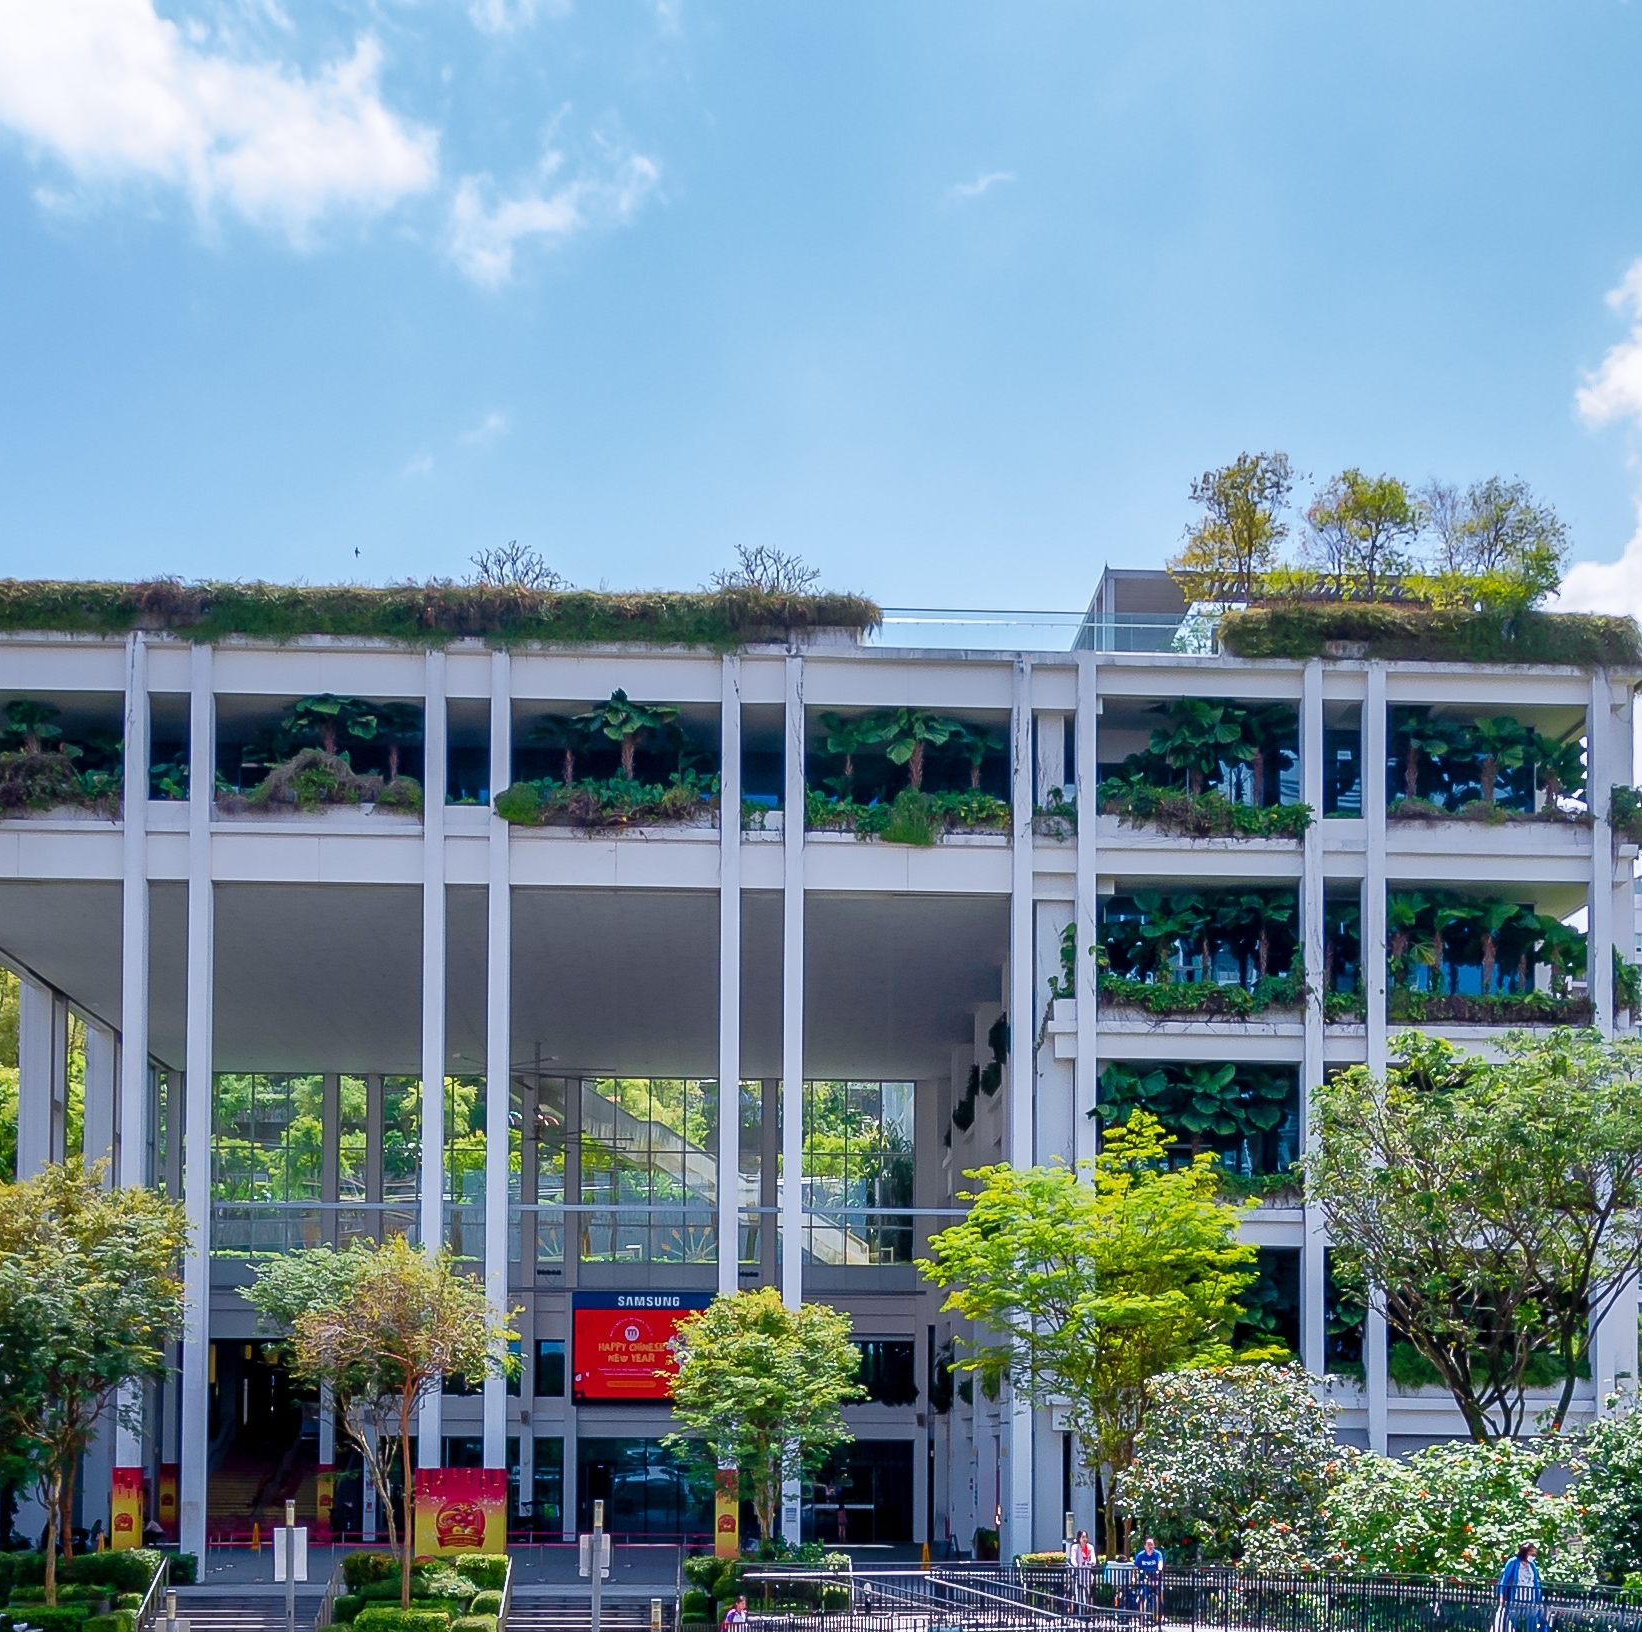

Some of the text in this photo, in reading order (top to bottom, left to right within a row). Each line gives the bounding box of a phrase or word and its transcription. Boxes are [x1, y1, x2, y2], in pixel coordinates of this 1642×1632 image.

[618, 1295, 680, 1307] SAMSUNG
[598, 1342, 665, 1352] HAPPY CHINESE
[631, 1353, 655, 1362] YEAR
